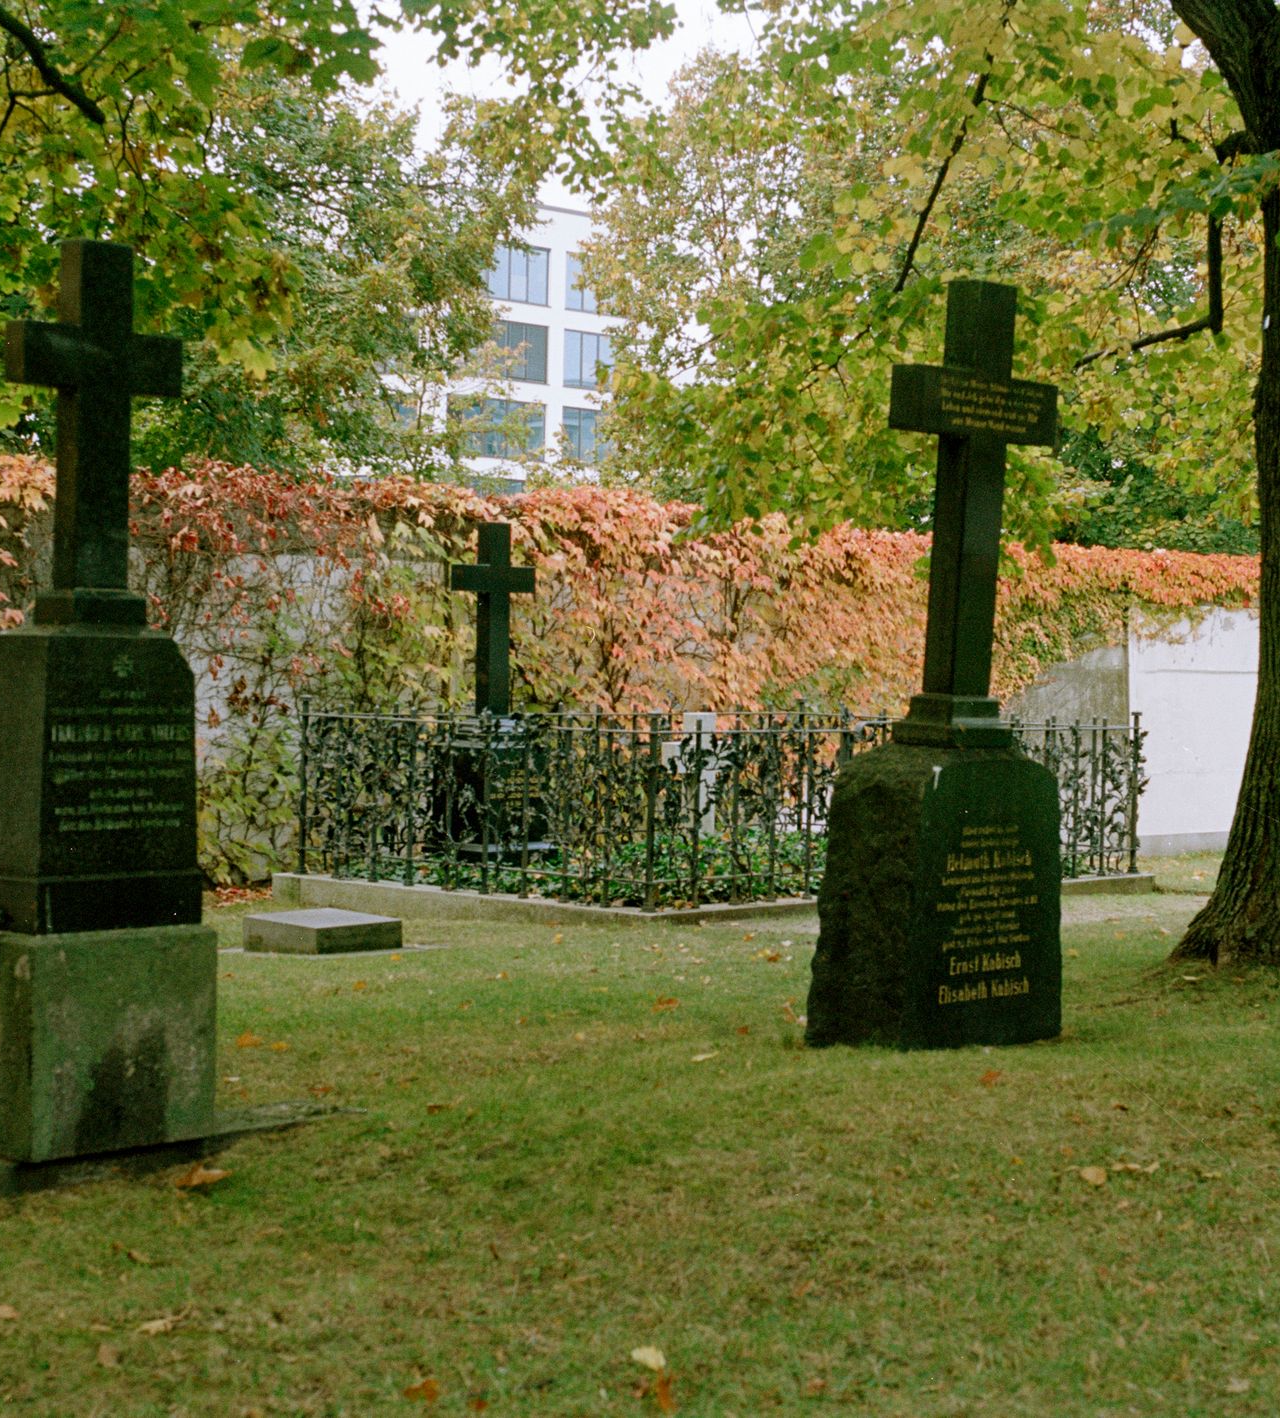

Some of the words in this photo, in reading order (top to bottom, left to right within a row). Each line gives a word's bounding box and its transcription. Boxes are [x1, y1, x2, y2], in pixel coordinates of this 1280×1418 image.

[949, 954, 980, 976] Ernst
[982, 950, 1022, 972] Kabisch
[938, 979, 988, 1005] Elisabeth
[991, 975, 1030, 998] Kabisch
